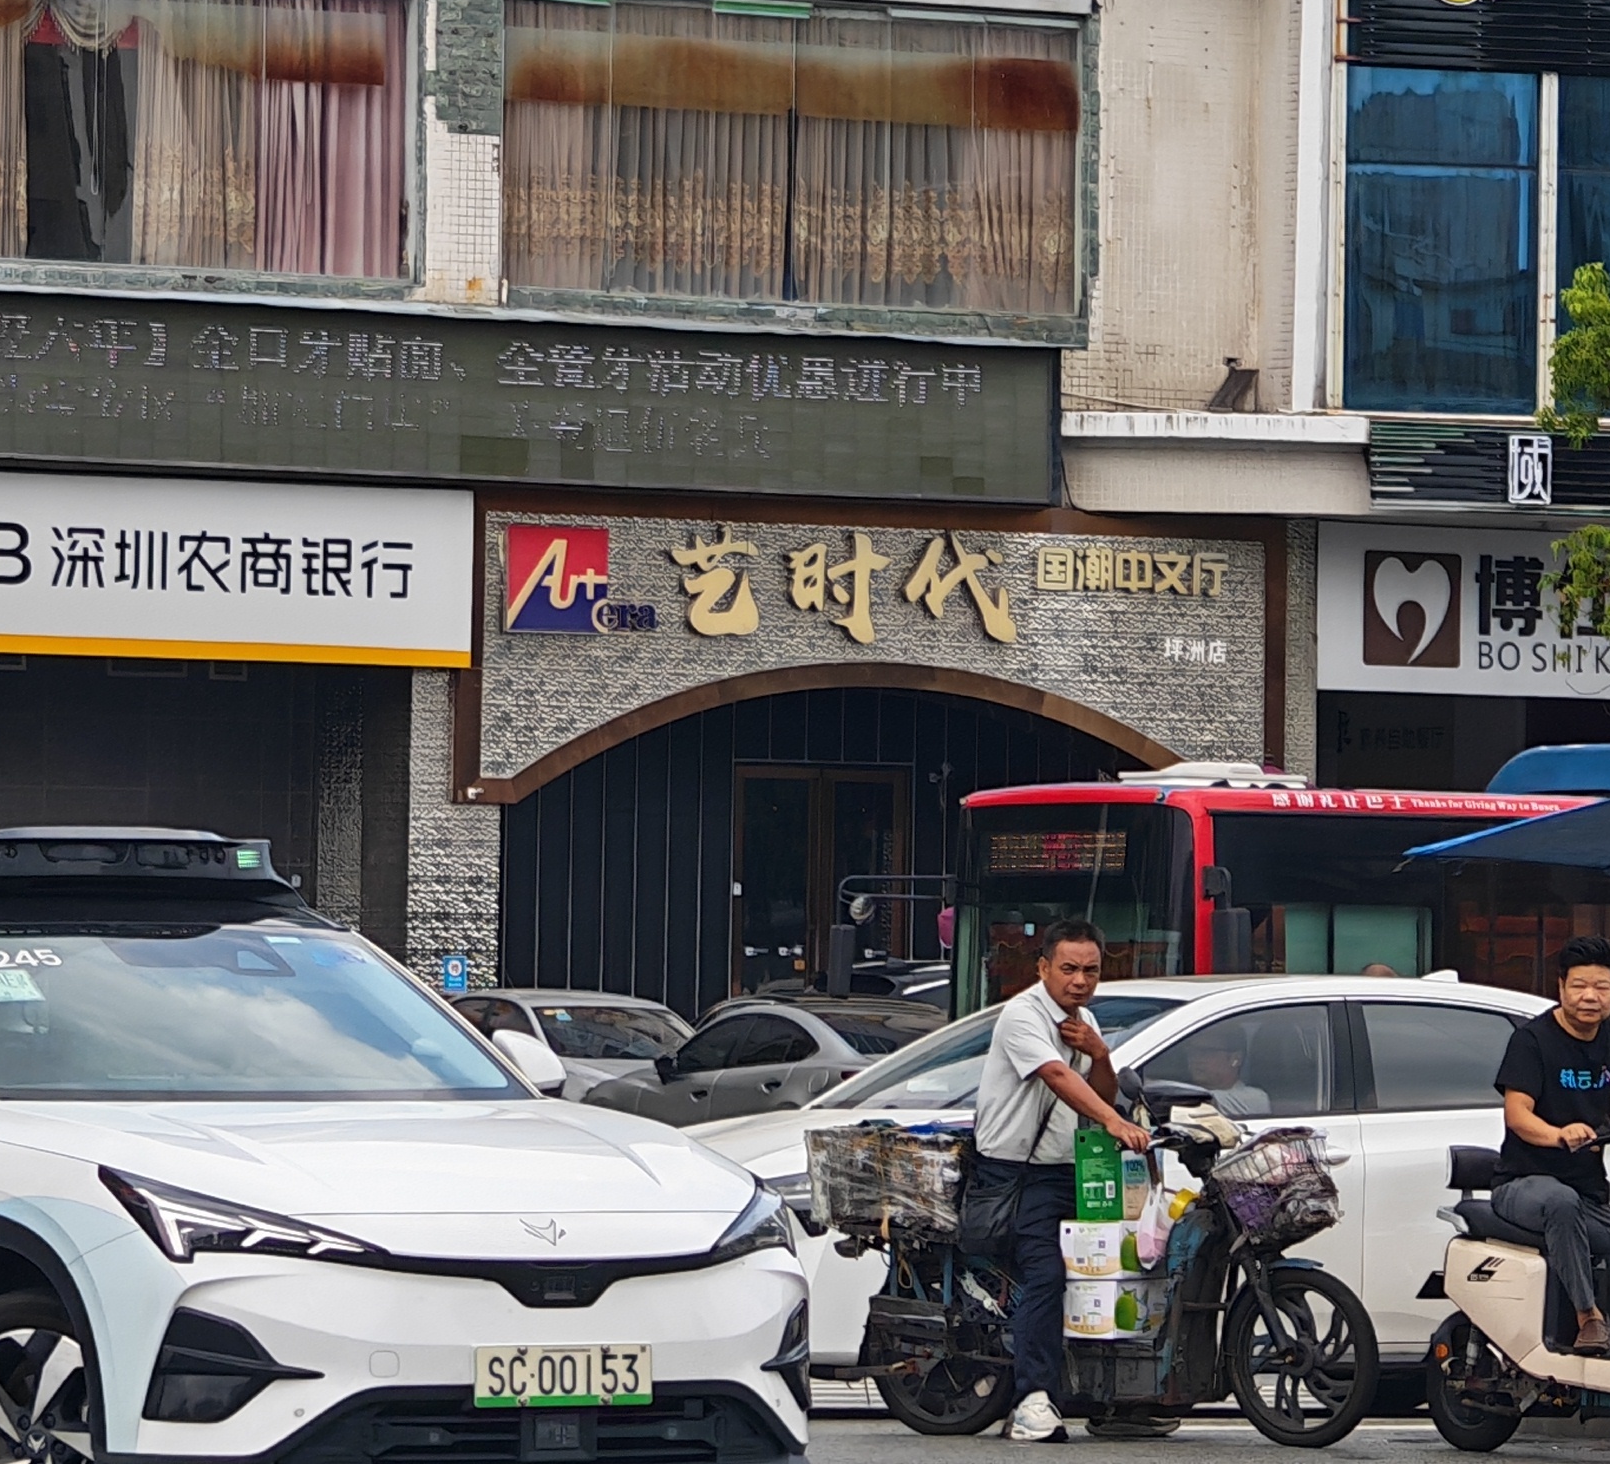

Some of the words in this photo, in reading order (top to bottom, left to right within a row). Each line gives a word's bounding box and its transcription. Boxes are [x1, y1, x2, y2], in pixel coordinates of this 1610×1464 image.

[51, 526, 412, 599] 深圳农商银行
[1037, 546, 1229, 597] 国潮中文厅
[671, 524, 1017, 645] 艺时代
[1164, 638, 1227, 664] 坪洲店
[1478, 641, 1521, 671] BO
[1531, 643, 1583, 673] SHI
[1411, 798, 1447, 808] Thanks
[1448, 799, 1463, 808] for
[1465, 800, 1496, 811] Giving
[1497, 801, 1518, 812] Way
[1520, 802, 1529, 810] to
